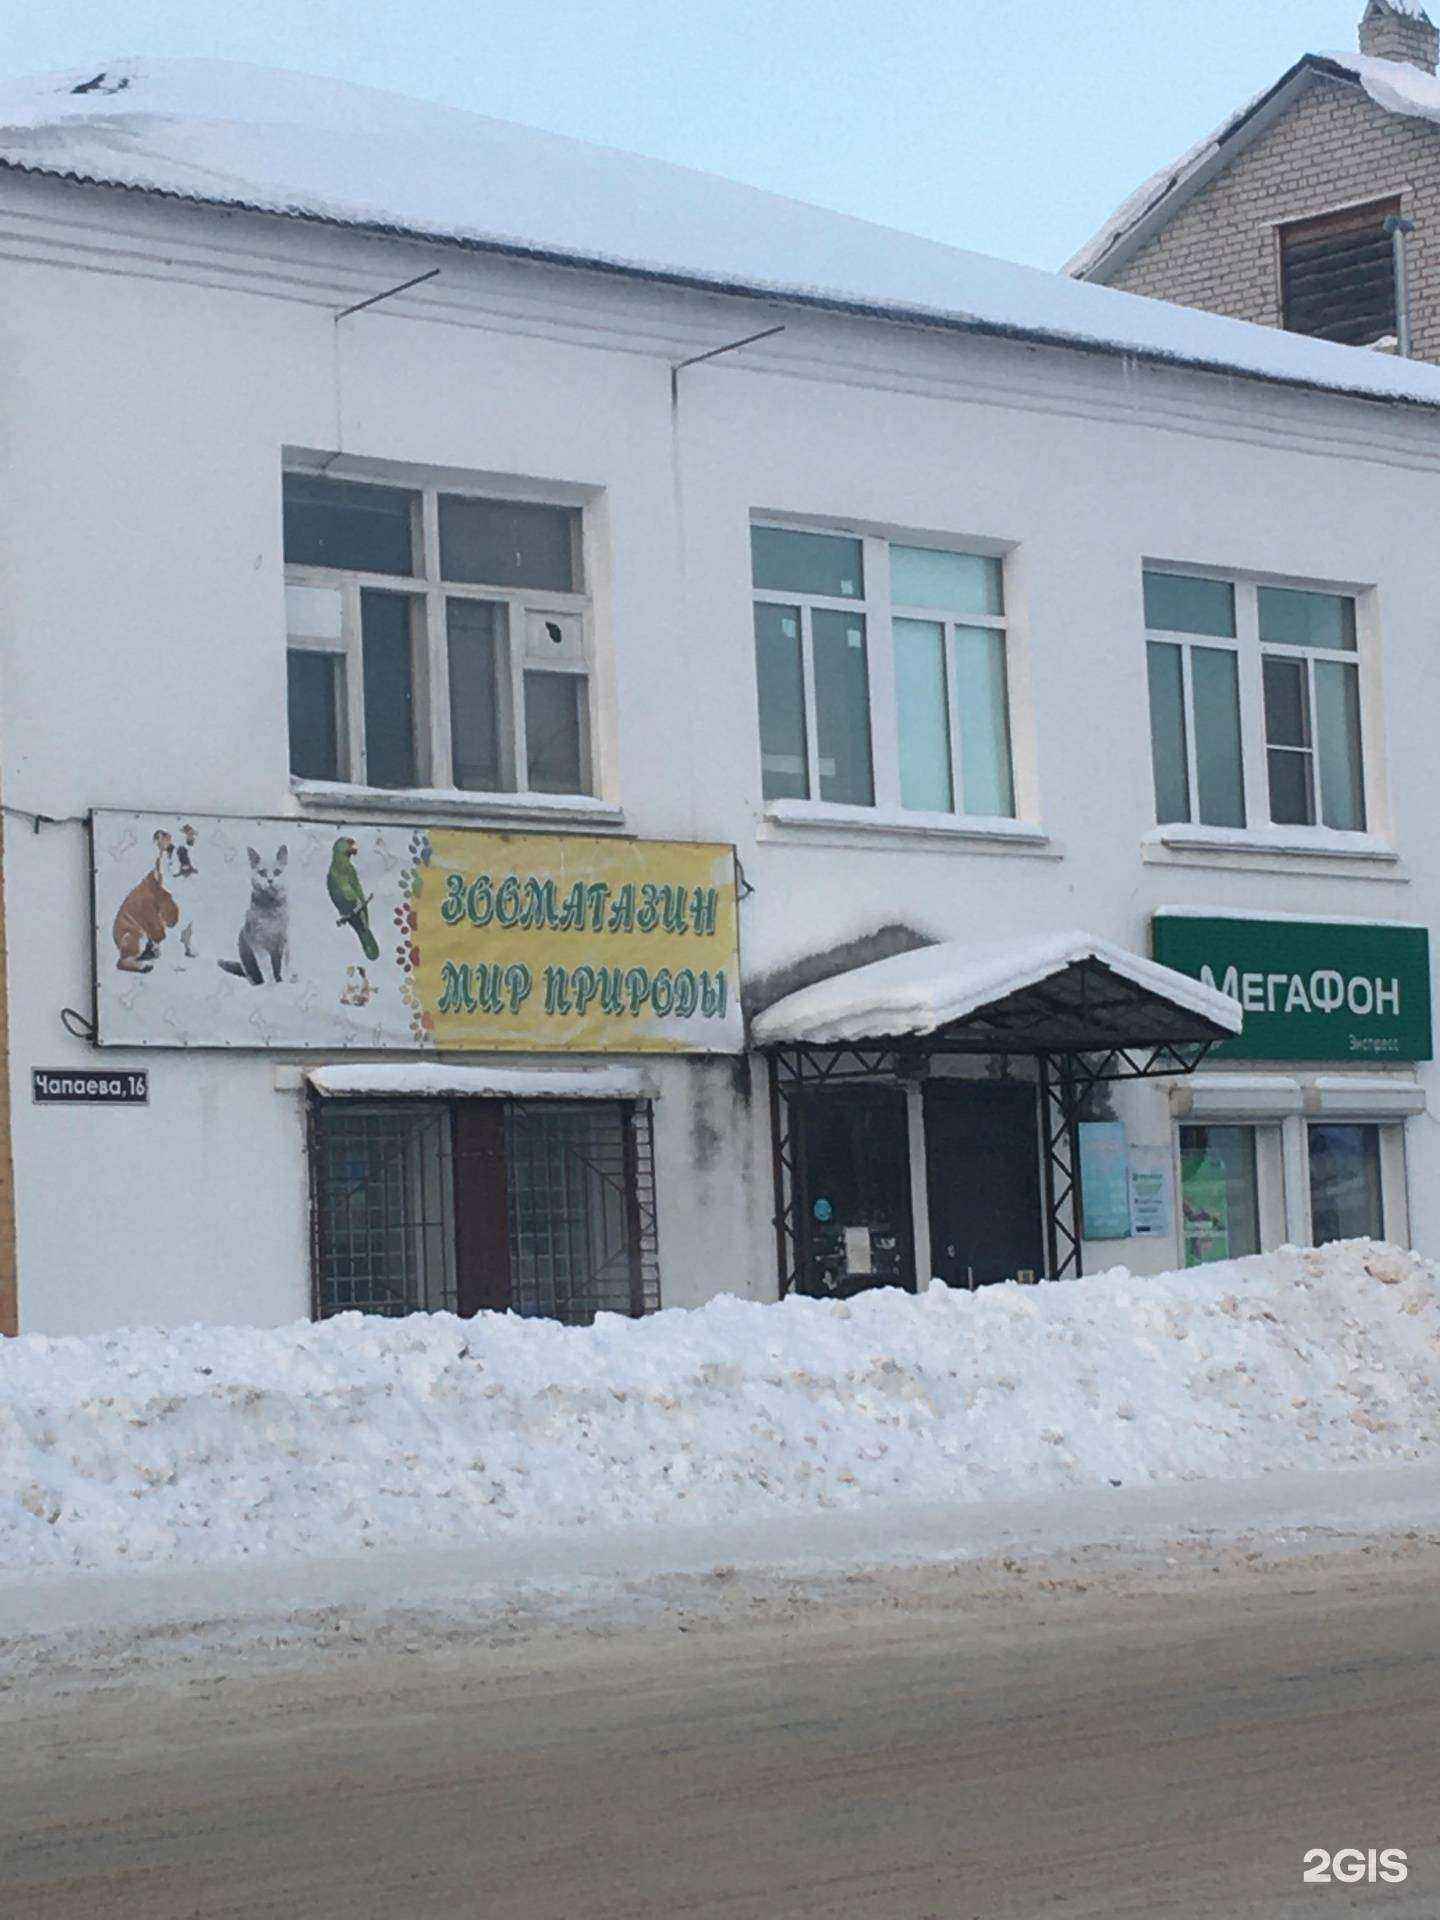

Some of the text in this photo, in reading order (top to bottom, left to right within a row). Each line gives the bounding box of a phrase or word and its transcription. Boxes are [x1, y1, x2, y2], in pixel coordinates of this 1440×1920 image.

[440, 872, 719, 936] ЗООМАГАЗИН
[437, 960, 728, 1019] МИР ПРИРОДЫ
